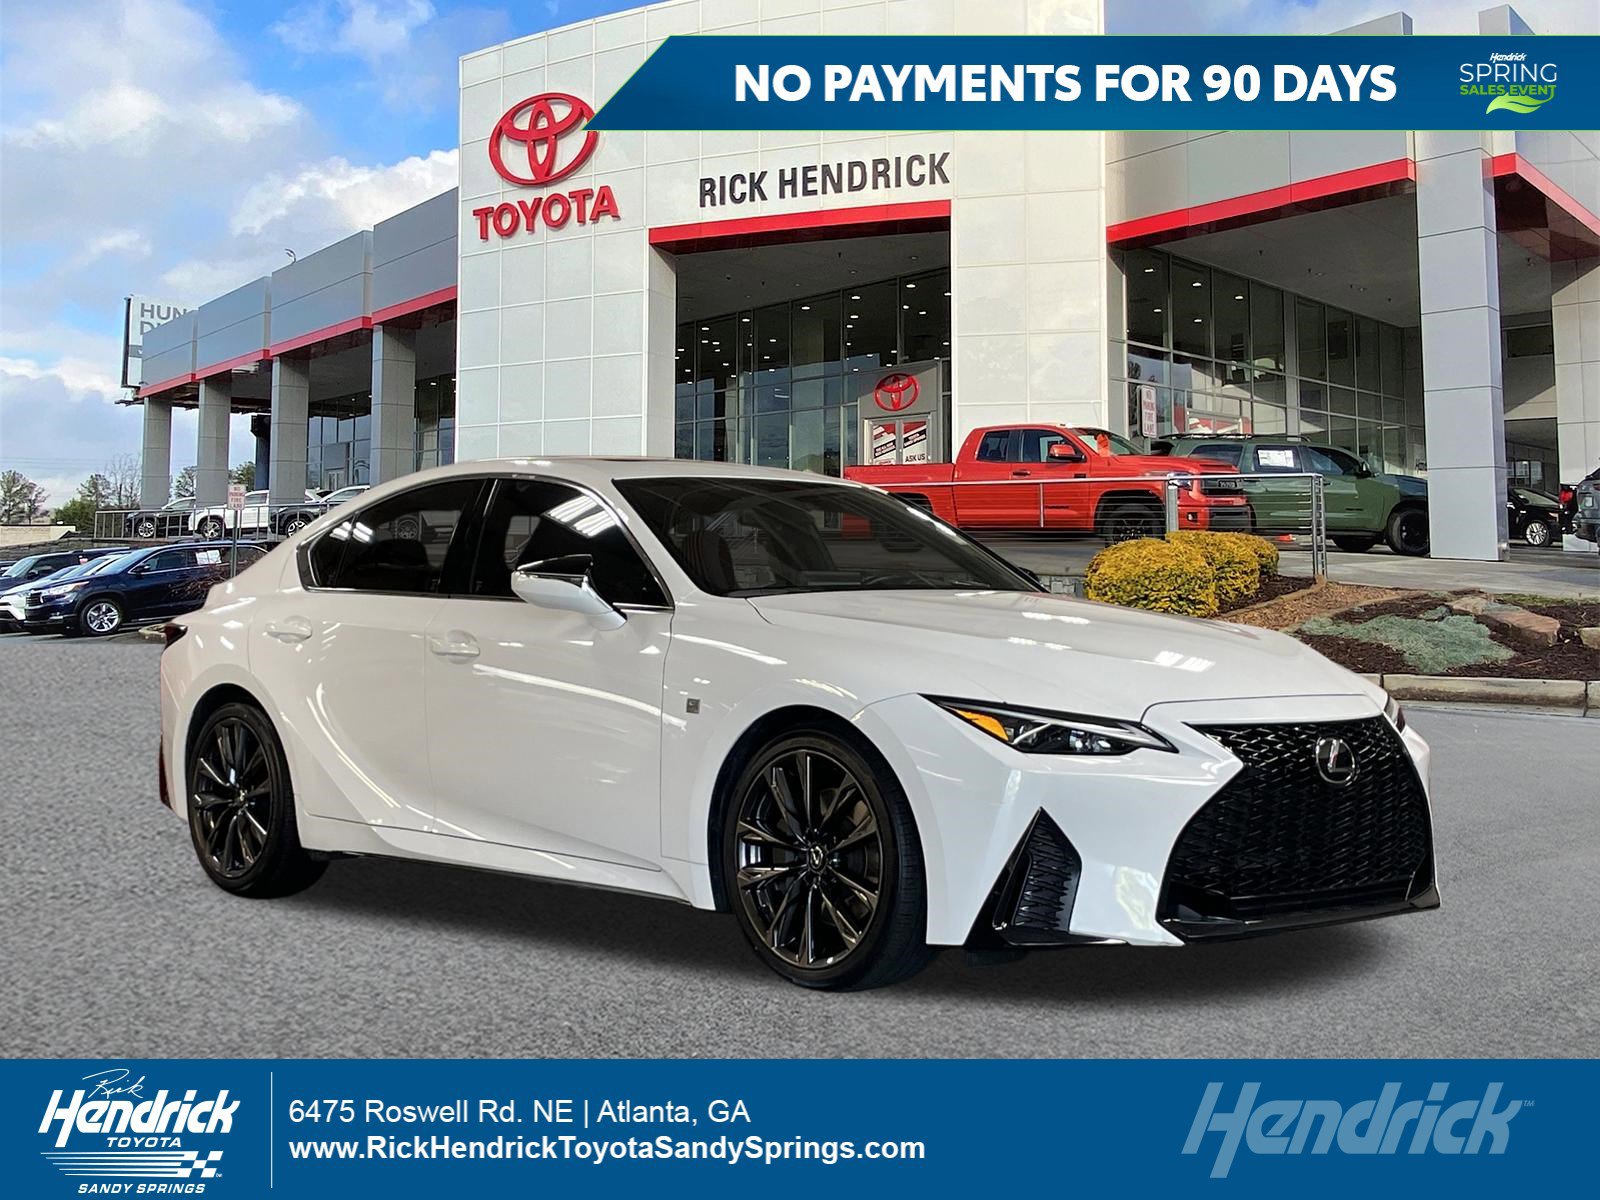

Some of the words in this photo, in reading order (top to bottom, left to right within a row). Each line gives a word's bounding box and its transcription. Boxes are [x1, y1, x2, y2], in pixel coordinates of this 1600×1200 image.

[699, 170, 768, 208] RICK
[779, 152, 950, 199] HENDRICK
[473, 185, 620, 240] TOYOTA
[905, 455, 917, 463] ASK
